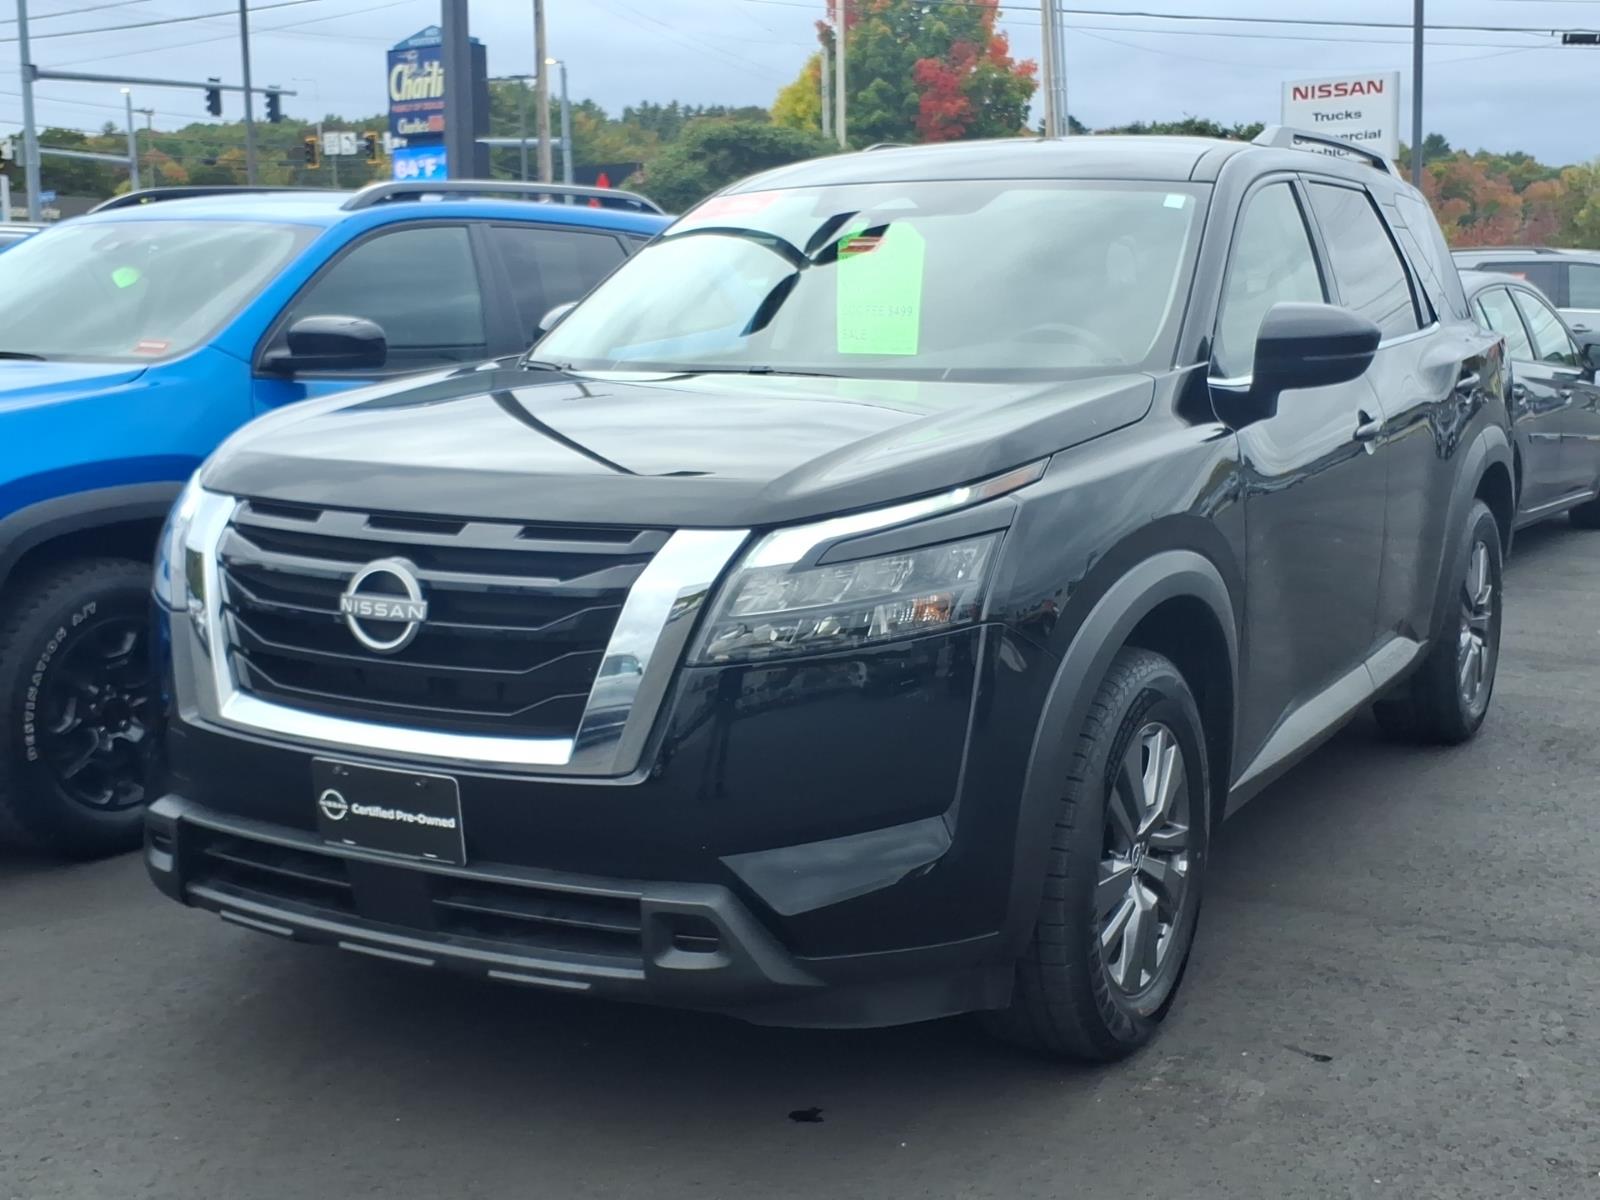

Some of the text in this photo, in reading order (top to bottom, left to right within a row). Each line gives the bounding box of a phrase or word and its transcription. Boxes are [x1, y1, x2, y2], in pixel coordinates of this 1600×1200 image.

[390, 60, 445, 101] Charli
[1292, 80, 1383, 101] NISSAN
[1312, 110, 1362, 122] Trucks
[341, 597, 424, 620] NISSAN
[351, 803, 456, 829] Certified Pre-Owned
